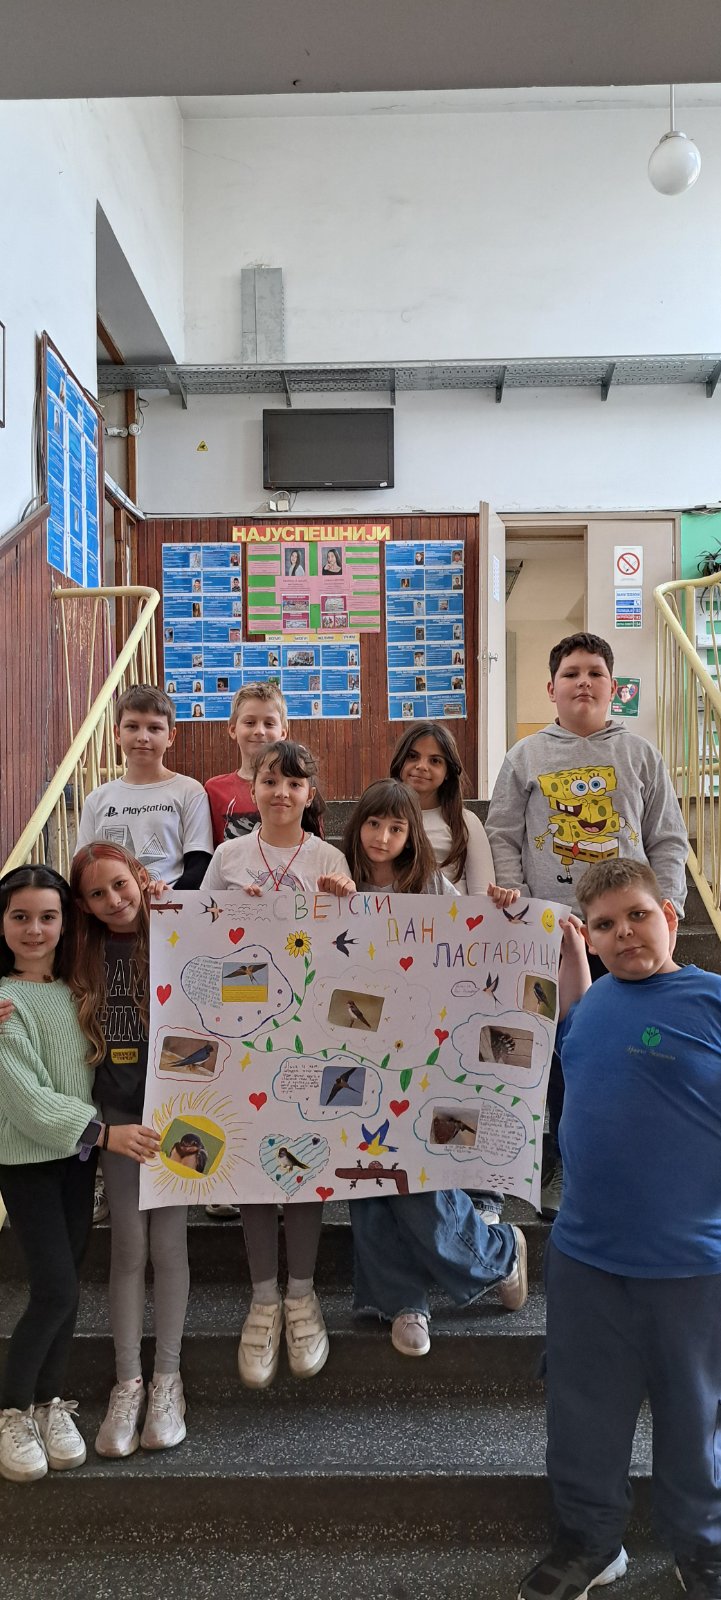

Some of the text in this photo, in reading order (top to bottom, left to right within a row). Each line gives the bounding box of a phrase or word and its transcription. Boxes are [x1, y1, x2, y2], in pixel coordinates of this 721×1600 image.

[232, 526, 391, 542] НАЈУСПЕШНИЈИ
[122, 803, 174, 816] PlayStation
[272, 894, 392, 920] СВЕТСКИ
[386, 917, 435, 947] ДАН
[433, 939, 558, 976] ЛАСТАВИЦА
